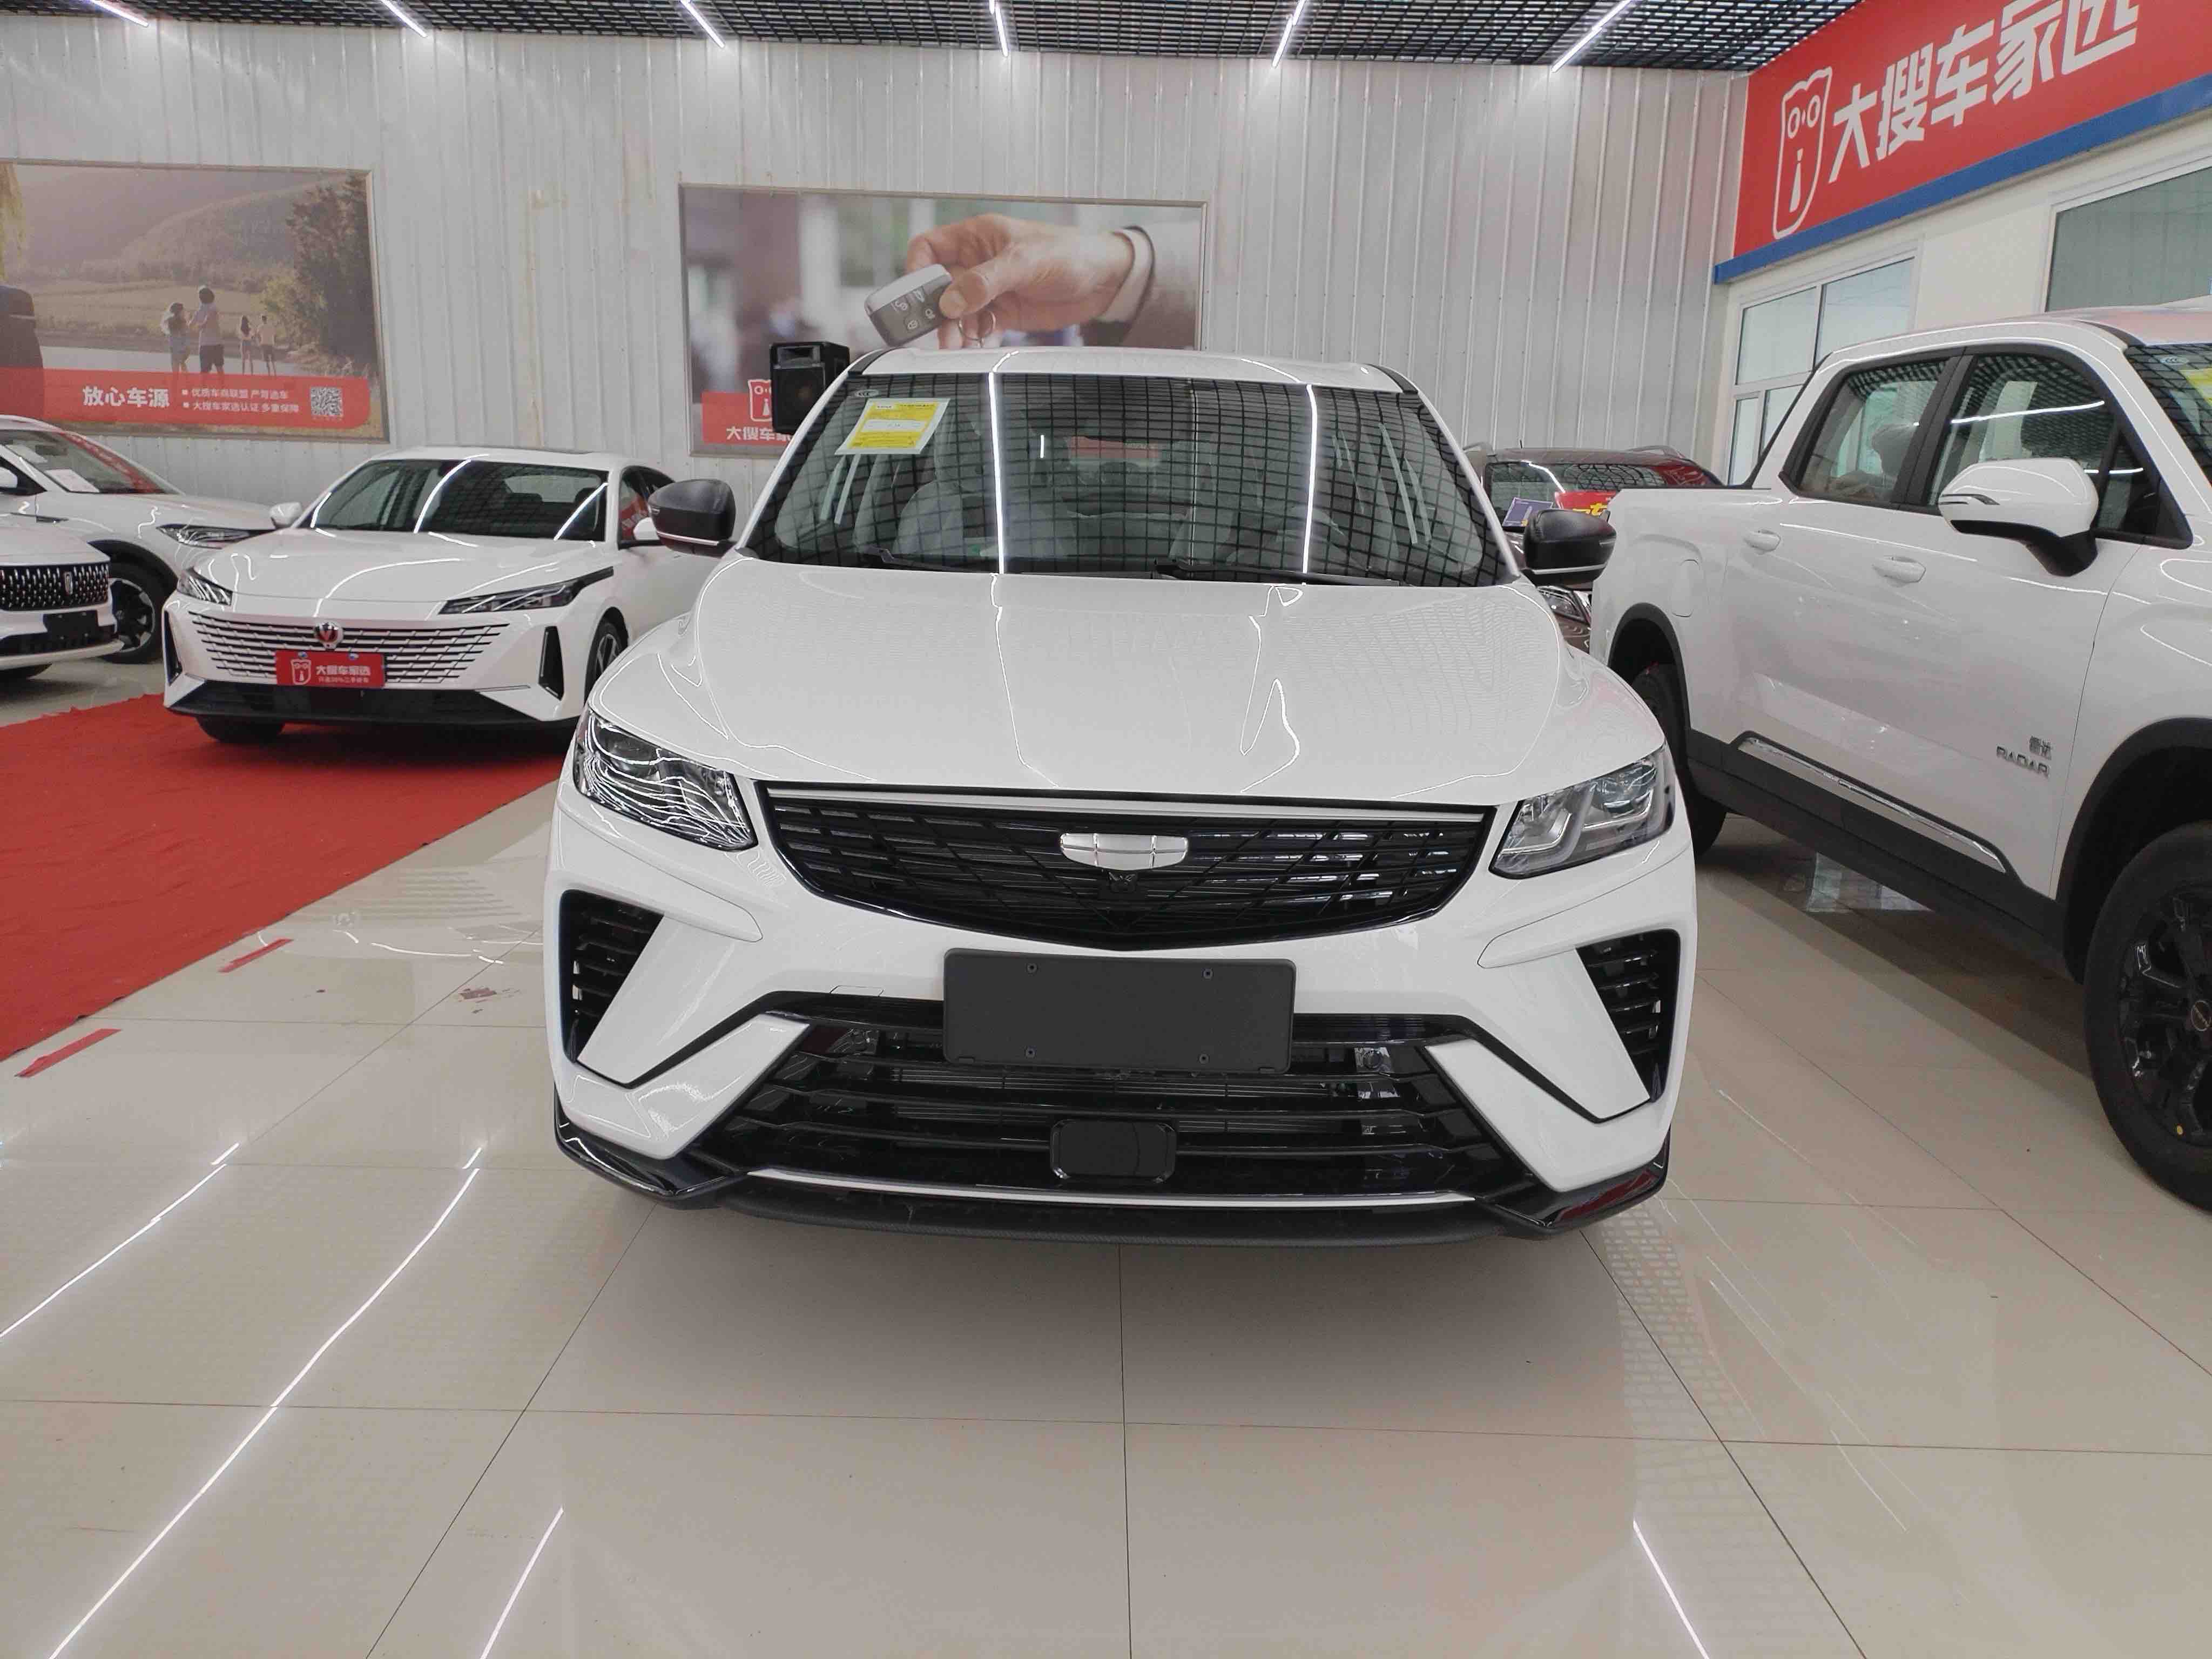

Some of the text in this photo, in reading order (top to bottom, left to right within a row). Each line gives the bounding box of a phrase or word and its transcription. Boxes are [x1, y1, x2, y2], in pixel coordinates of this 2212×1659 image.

[83, 386, 170, 408] 放心车源
[1997, 745, 2050, 779] RADAR
